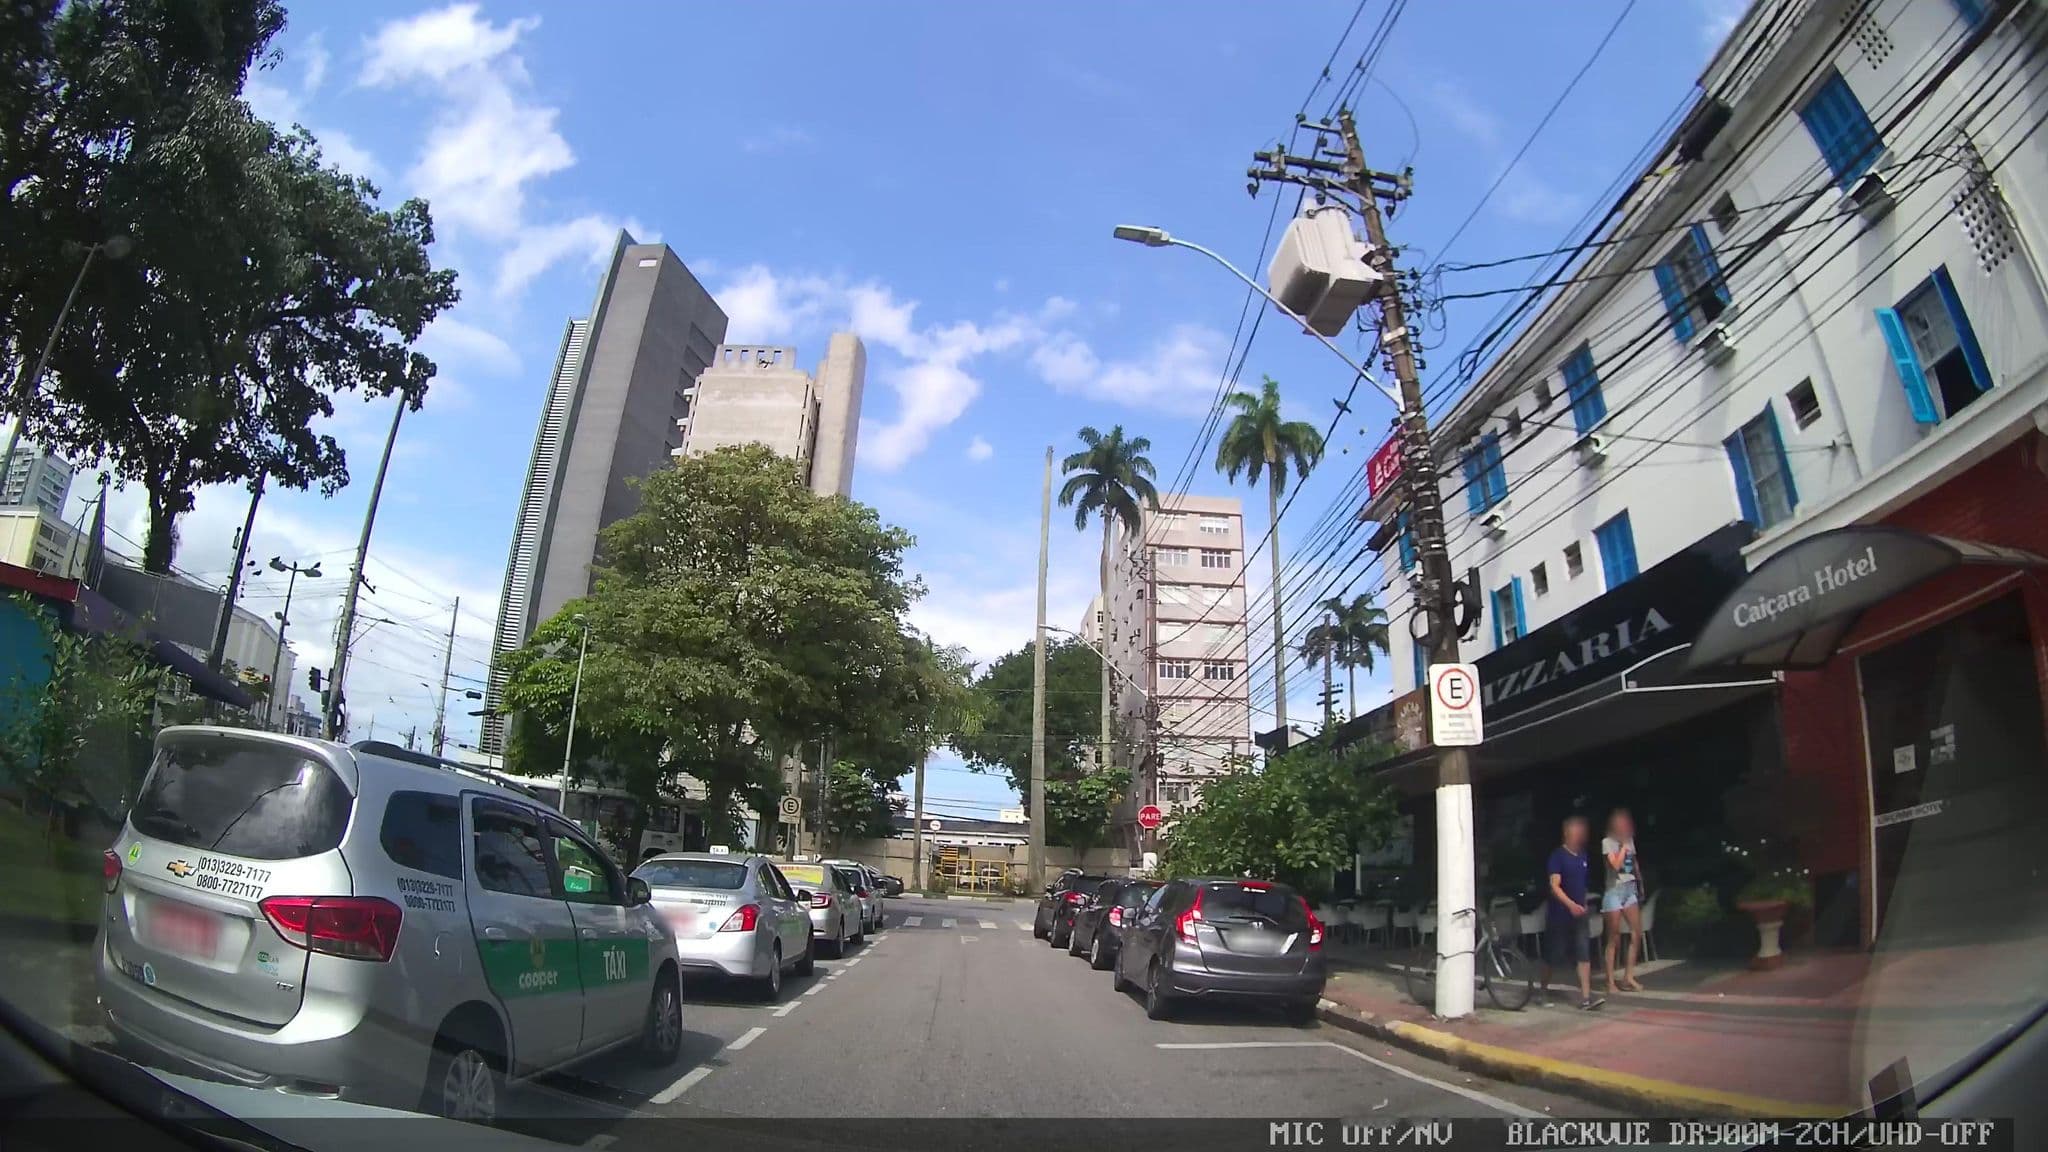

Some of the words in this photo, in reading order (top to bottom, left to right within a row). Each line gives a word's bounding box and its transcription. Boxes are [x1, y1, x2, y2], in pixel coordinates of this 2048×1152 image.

[1733, 585, 1811, 628] Caiçara
[1814, 546, 1878, 595] Hotel
[1483, 607, 1673, 706] IZZARIA
[1450, 678, 1462, 699] E
[788, 801, 794, 811] E
[1140, 813, 1161, 821] PARE
[197, 856, 272, 883] (013)3229-7177
[196, 874, 263, 899] 0800-7727177
[603, 945, 626, 980] TÁXI
[519, 970, 558, 991] cooper
